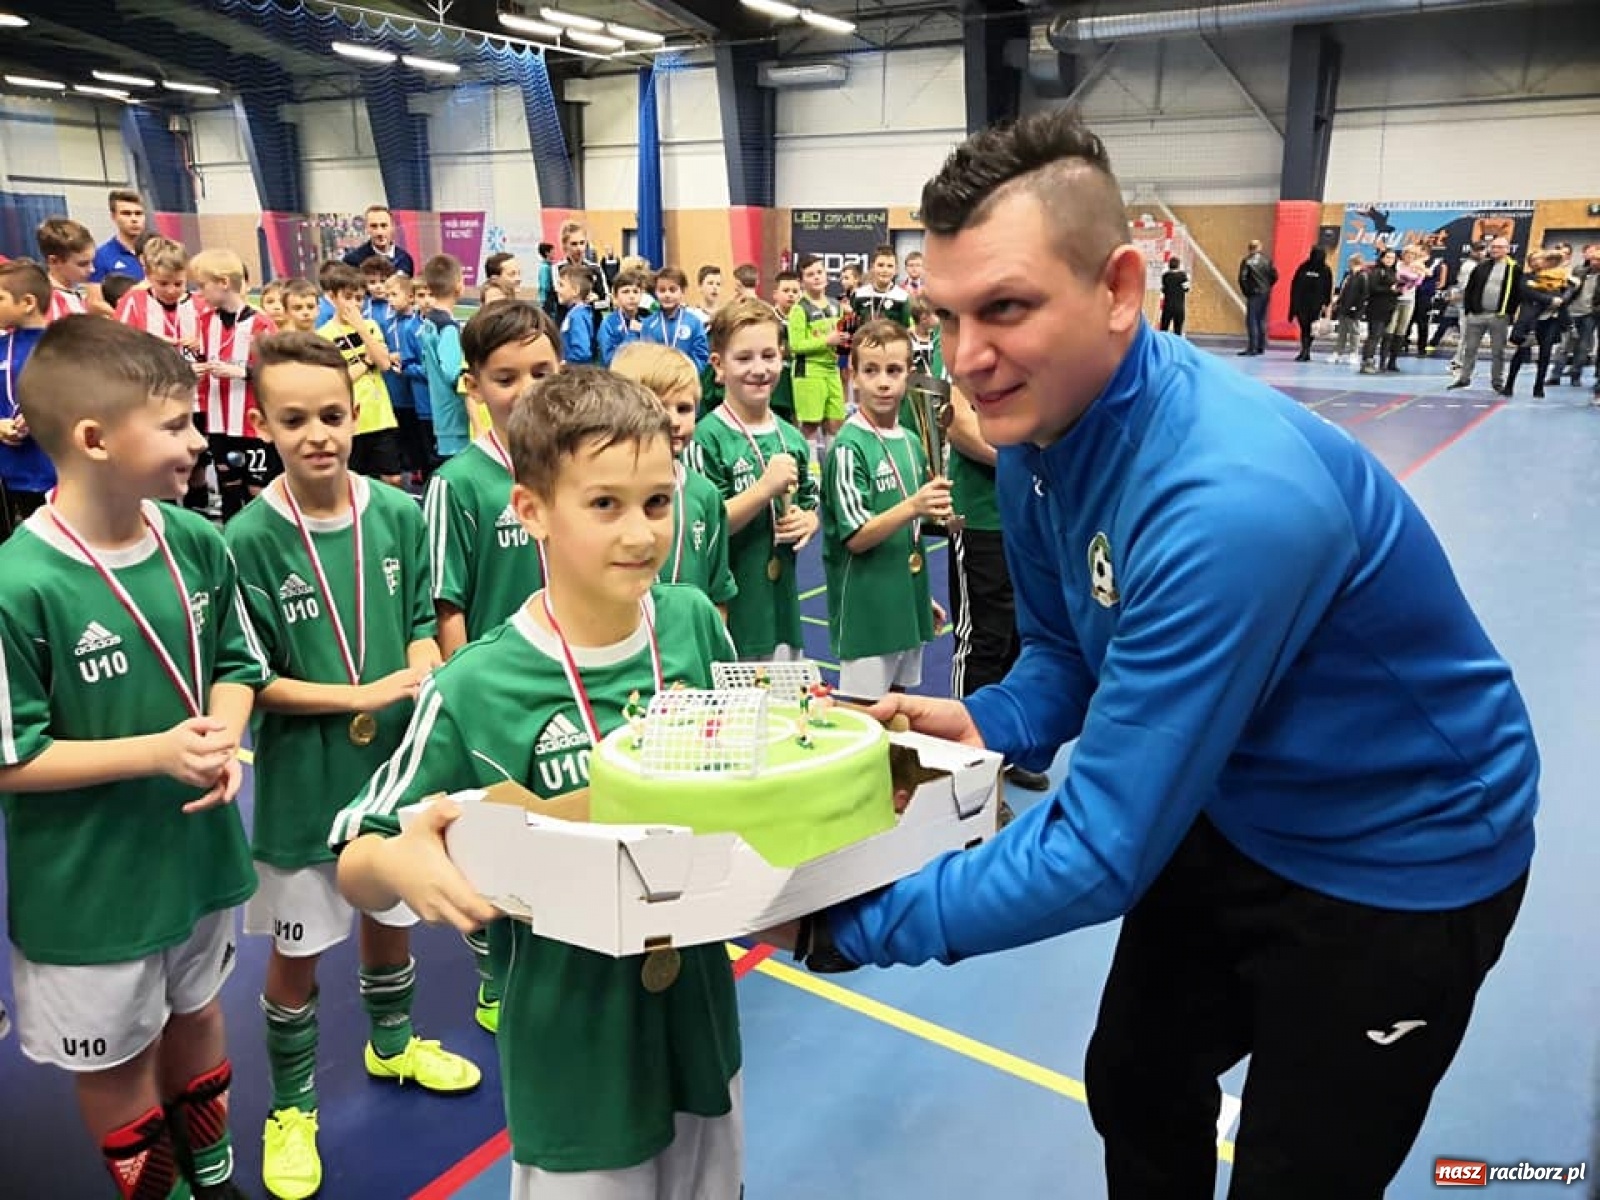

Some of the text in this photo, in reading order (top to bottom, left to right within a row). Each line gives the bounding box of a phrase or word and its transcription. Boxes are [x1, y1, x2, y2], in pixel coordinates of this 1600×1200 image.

[245, 448, 268, 473] 22
[497, 526, 529, 548] U10
[282, 597, 319, 623] U10
[79, 651, 128, 683] U10
[274, 918, 304, 942] U10
[62, 1037, 107, 1059] U10
